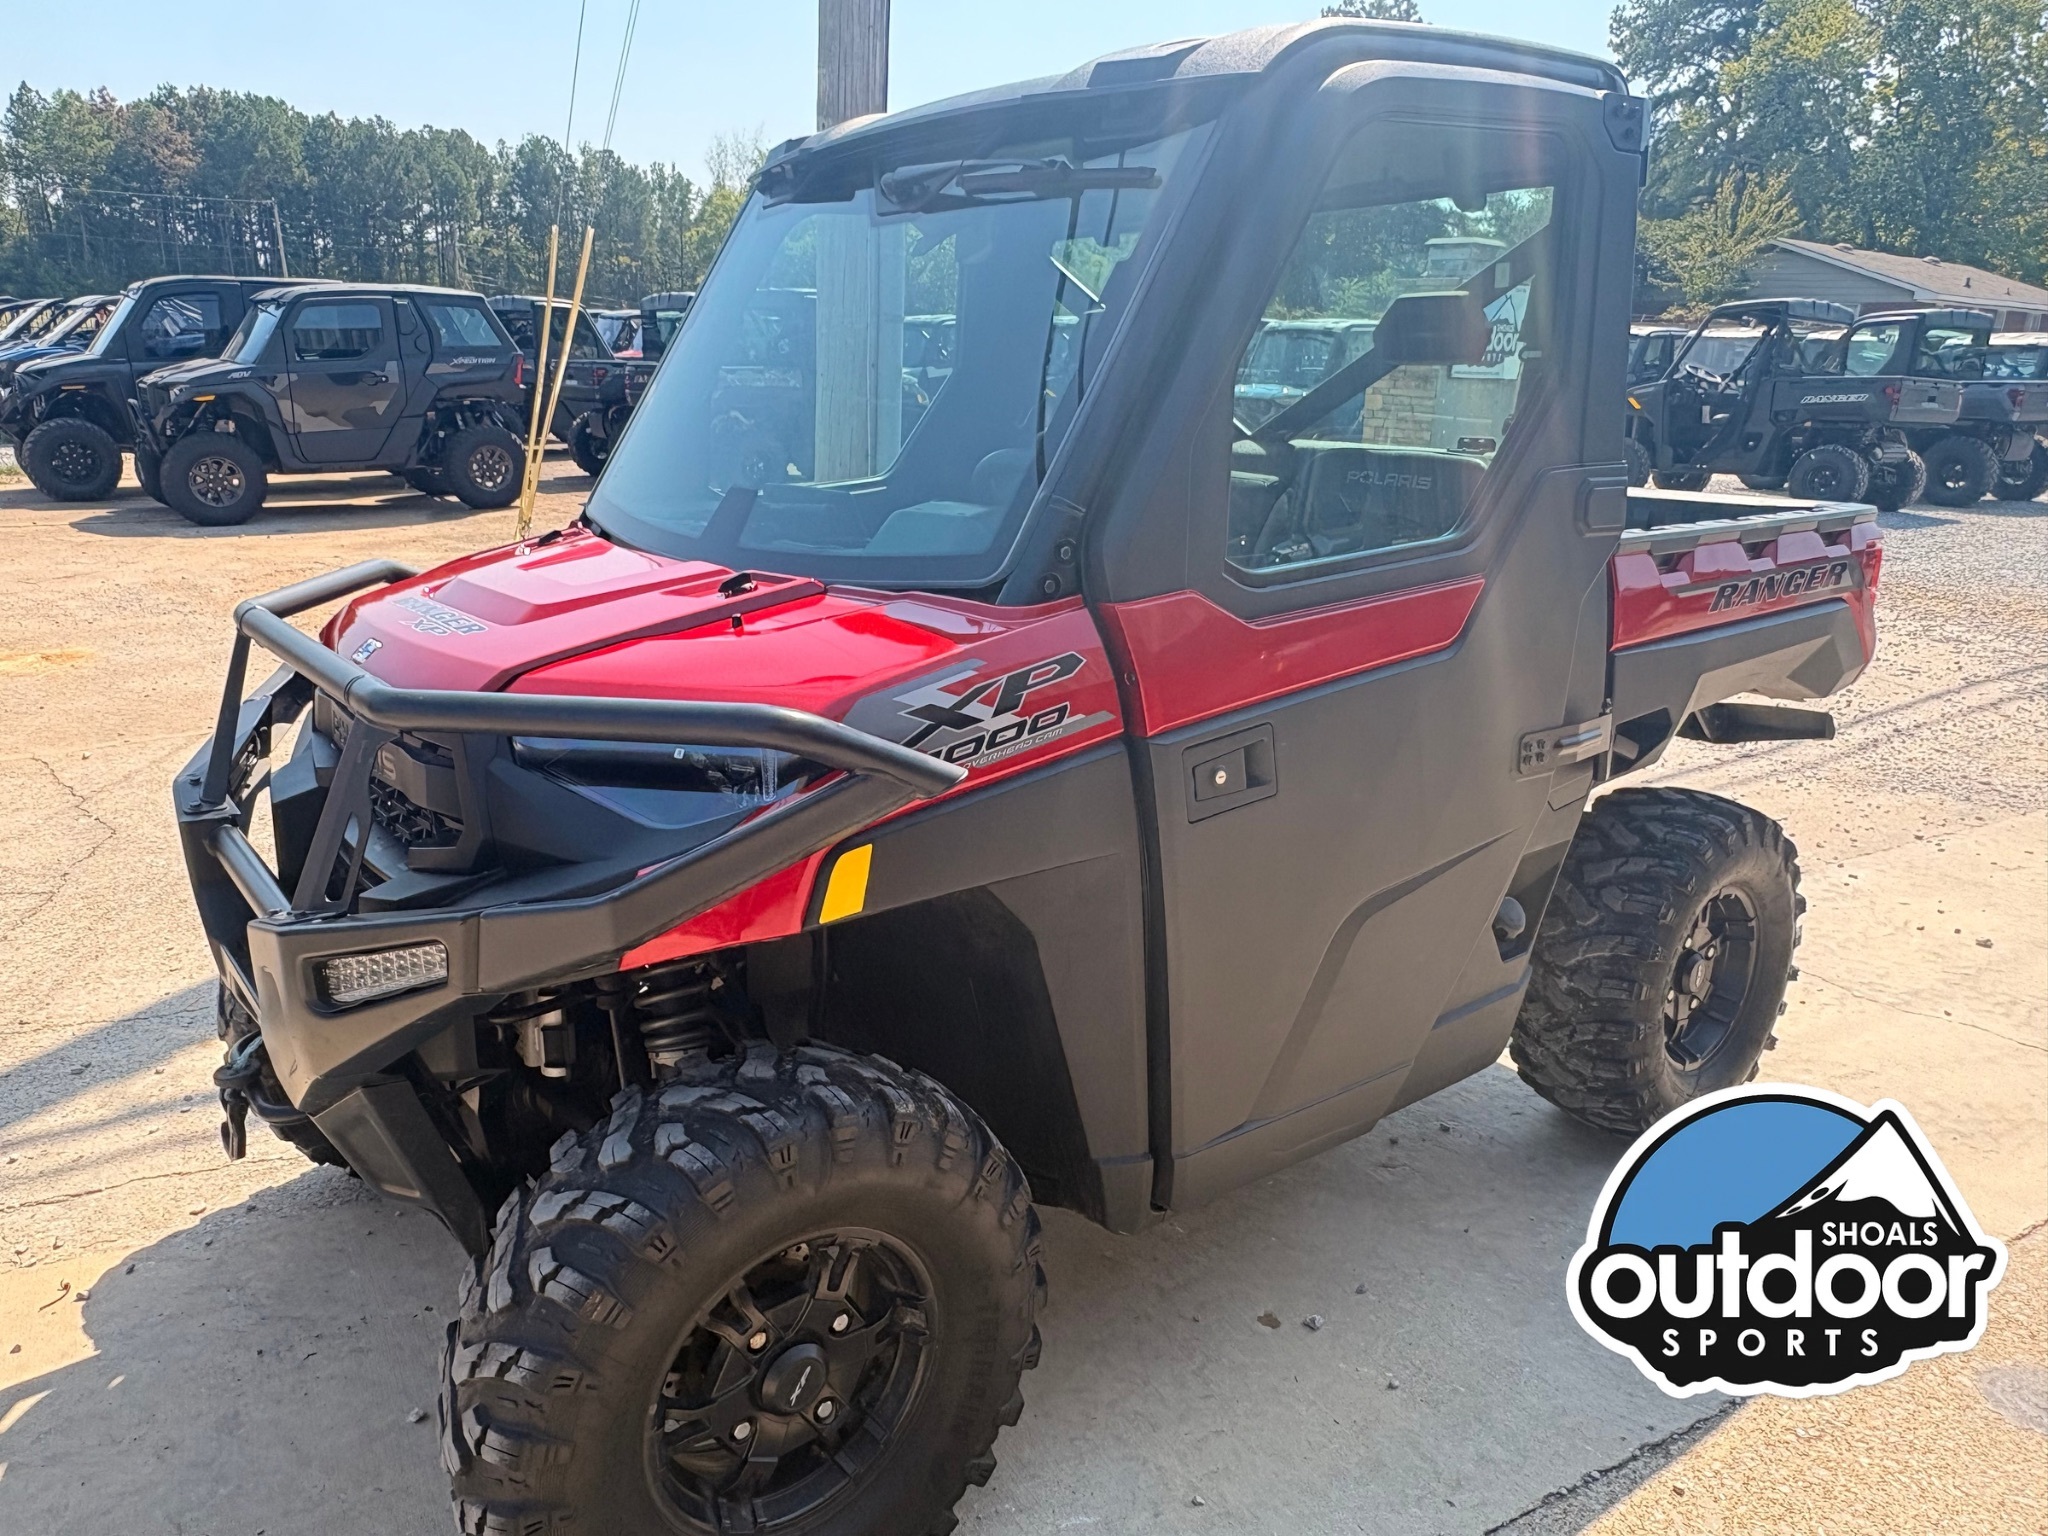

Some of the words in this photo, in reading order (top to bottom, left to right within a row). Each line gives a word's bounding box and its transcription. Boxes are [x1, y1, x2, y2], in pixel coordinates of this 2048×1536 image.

[1346, 470, 1432, 490] POLARIS
[1707, 560, 1849, 614] RANGER
[897, 651, 1087, 750] XP
[1035, 727, 1063, 743] CAM
